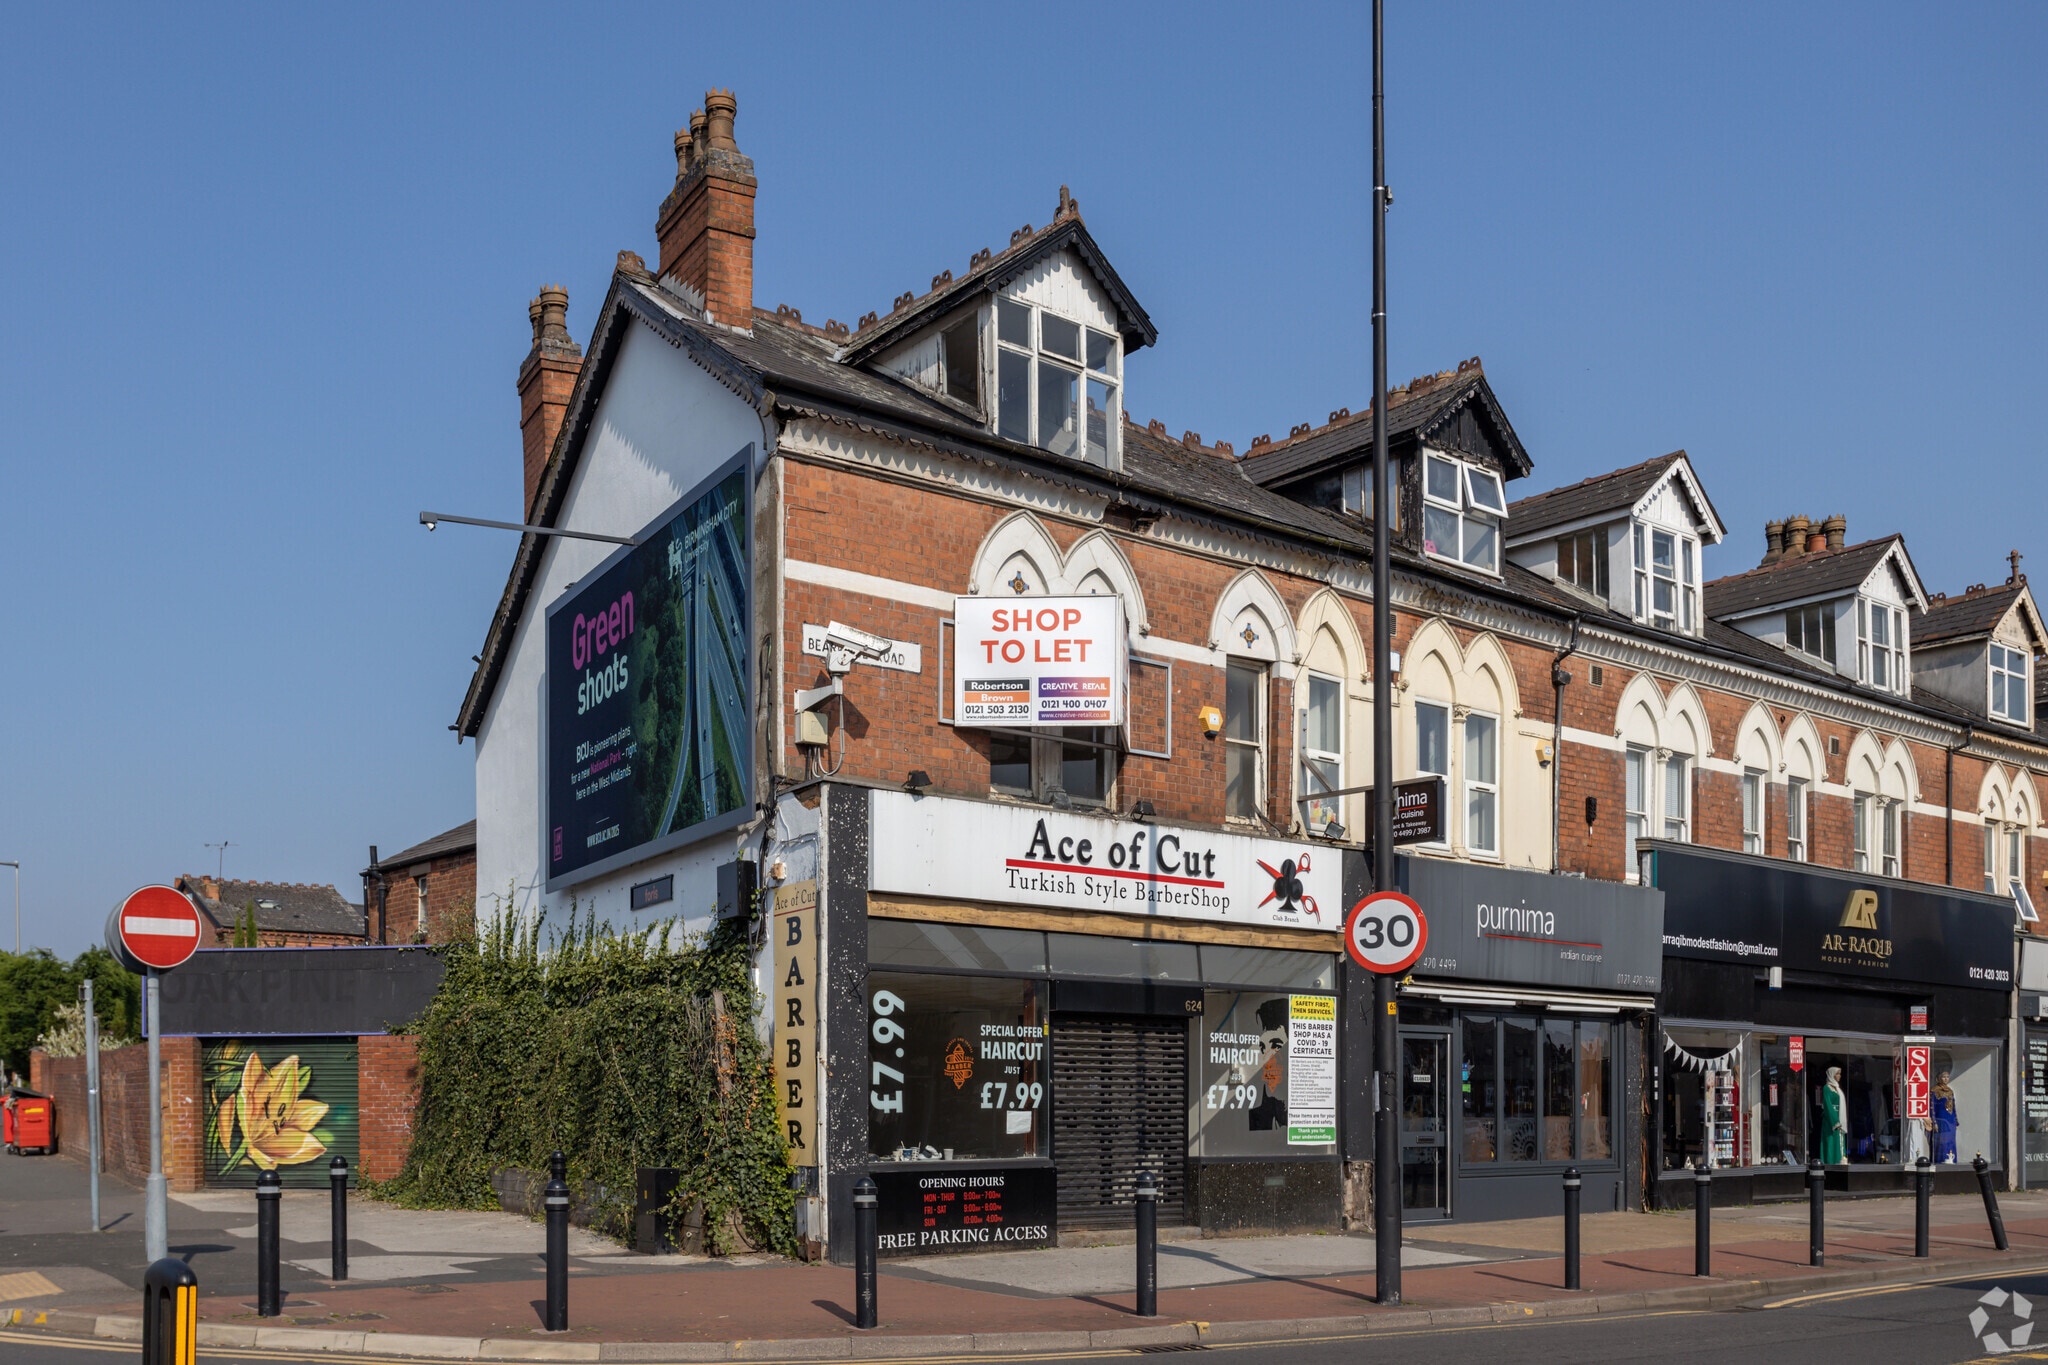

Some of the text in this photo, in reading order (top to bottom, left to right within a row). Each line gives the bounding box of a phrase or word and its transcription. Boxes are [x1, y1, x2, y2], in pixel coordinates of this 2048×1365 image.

[685, 498, 737, 549] BIRMINGHAM CITY
[991, 608, 1082, 632] SHOP
[572, 589, 634, 671] Green
[880, 651, 905, 666] OAD
[980, 639, 1093, 664] TO LET
[577, 652, 629, 716] shoots
[971, 682, 1024, 690] Robertson
[981, 693, 1014, 702] Brown
[1041, 700, 1107, 709] 0121 400 0407
[965, 705, 1029, 714] 0121 503 2130
[576, 740, 590, 763] BCU
[594, 733, 617, 757] pioneering
[618, 726, 631, 744] plans
[590, 756, 609, 774] National
[610, 749, 621, 765] Park
[1400, 810, 1424, 819] cuisine
[1405, 820, 1427, 828] Takeaway
[1417, 826, 1431, 835] 3987
[1024, 817, 1217, 879] Ace of Cut
[1005, 868, 1231, 914] Turkish Style BarberShop
[774, 889, 816, 911] Ace of Cut
[1477, 899, 1555, 938] purnima
[1358, 914, 1415, 950] 30
[1821, 933, 1893, 957] AR-RAQIB
[1560, 949, 1602, 963] indian cuisine
[1821, 955, 1852, 965] MODEST
[1969, 966, 2009, 982] 0121 420 3033
[1185, 1000, 1202, 1012] 624
[1315, 1001, 1331, 1009] FIRST,
[784, 916, 806, 1151] BARBER
[980, 1024, 1043, 1039] SPECIAL OFFER
[1292, 1022, 1333, 1031] THIS BARBER
[1210, 1032, 1260, 1046] SPECIAL OFFER
[1294, 1031, 1311, 1039] SHOP
[1312, 1031, 1325, 1039] HAS
[870, 989, 905, 1114] £7.99
[980, 1041, 1043, 1062] HAIRCUT
[1210, 1046, 1260, 1066] HAIRCUT
[1293, 1047, 1332, 1056] CERTIFICATE
[1004, 1066, 1021, 1075] JUST
[1908, 1049, 1928, 1116] SALE
[980, 1082, 1043, 1110] £7.99
[1207, 1085, 1257, 1110] £7.99
[919, 1176, 1005, 1189] OPENING HOURS
[923, 1193, 937, 1202] MON
[941, 1192, 955, 1201] THUR
[923, 1206, 933, 1215] FRI
[937, 1205, 947, 1214] SAT
[924, 1218, 936, 1227] SUN
[878, 1225, 1048, 1249] FREE PARKING ACCESS
